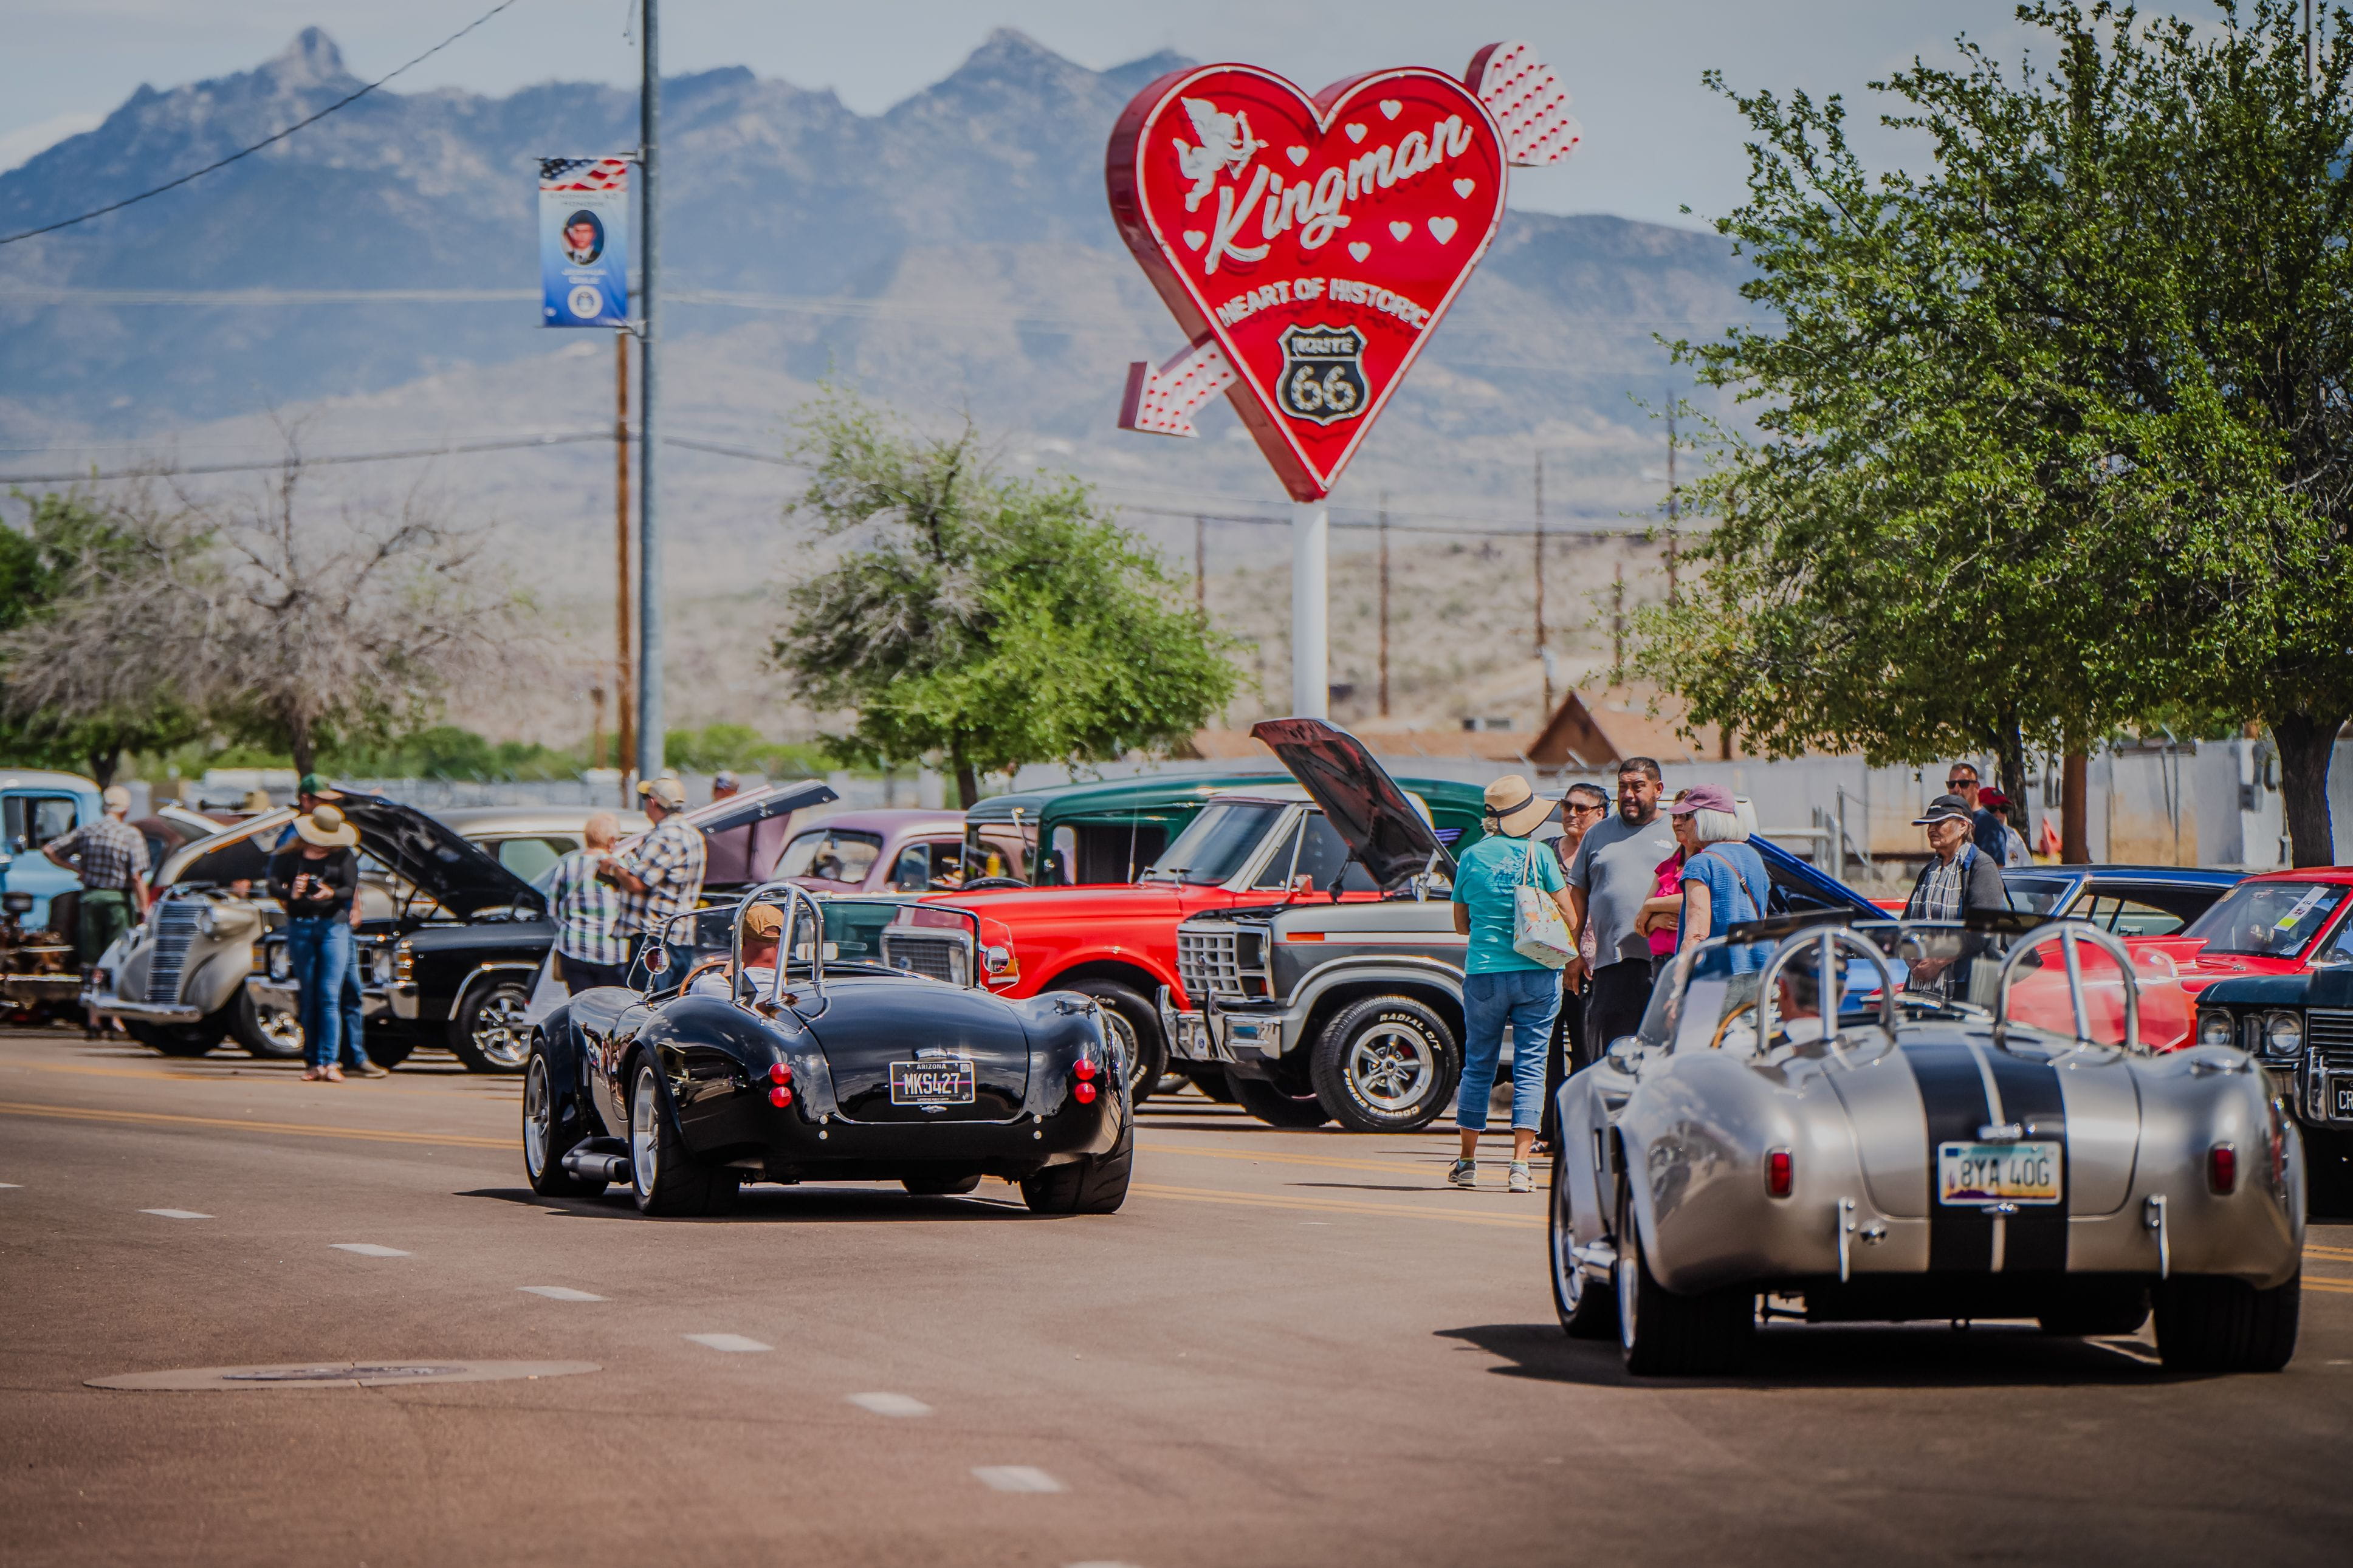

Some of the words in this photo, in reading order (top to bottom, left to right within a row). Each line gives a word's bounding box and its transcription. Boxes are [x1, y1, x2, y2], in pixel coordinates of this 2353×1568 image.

[1205, 114, 1474, 275] Kingman
[1215, 280, 1291, 327] HEART
[1293, 277, 1325, 301] OF
[1330, 278, 1431, 330] HISTORIC
[1292, 337, 1355, 354] ROUTE
[1291, 365, 1357, 411] 66
[1379, 1013, 1423, 1030] RADIAL
[1425, 1031, 1442, 1051] G/T
[904, 1072, 961, 1095] MKS427
[1343, 1068, 1369, 1108] COBRA
[1369, 1105, 1420, 1117] COOPER
[1961, 1159, 1999, 1186] 8YA
